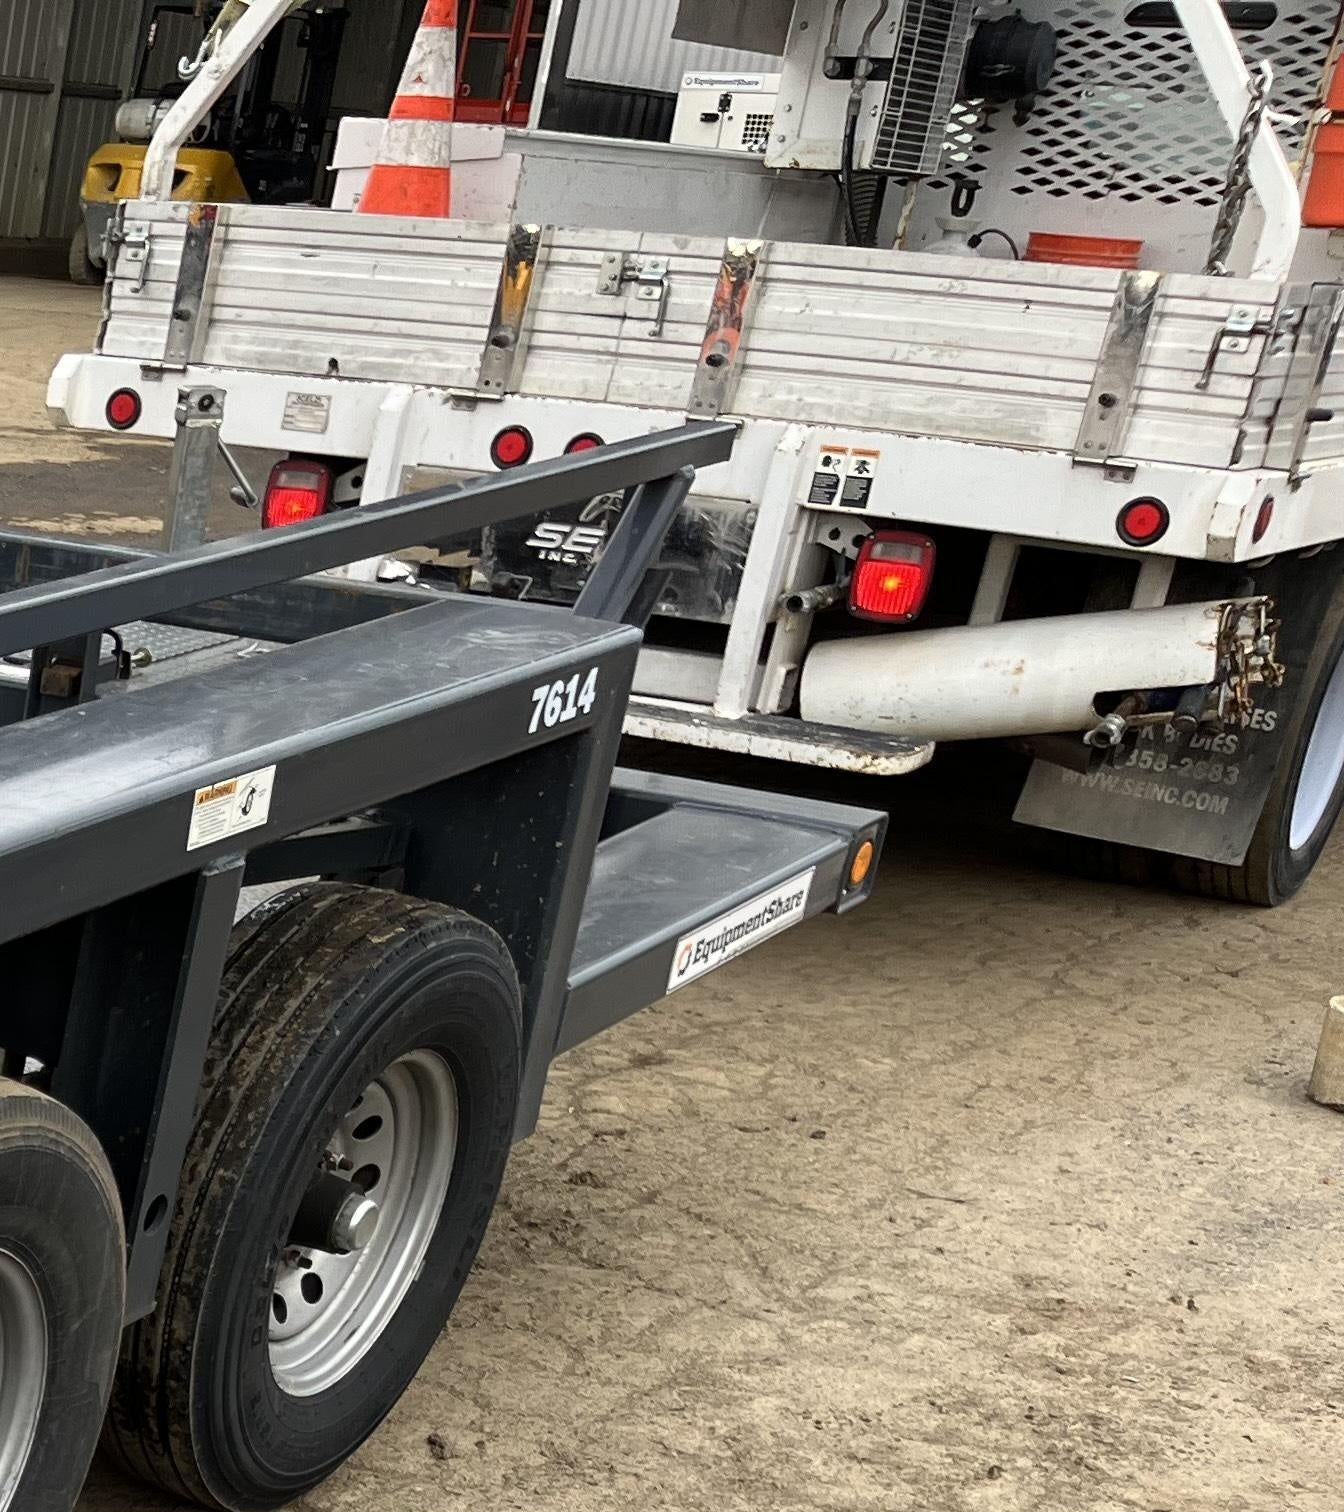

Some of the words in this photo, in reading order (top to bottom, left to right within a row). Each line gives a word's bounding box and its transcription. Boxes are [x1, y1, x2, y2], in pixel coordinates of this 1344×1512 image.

[525, 522, 608, 553] SE
[528, 667, 598, 734] 7614
[692, 889, 804, 965] EquipmentShare
